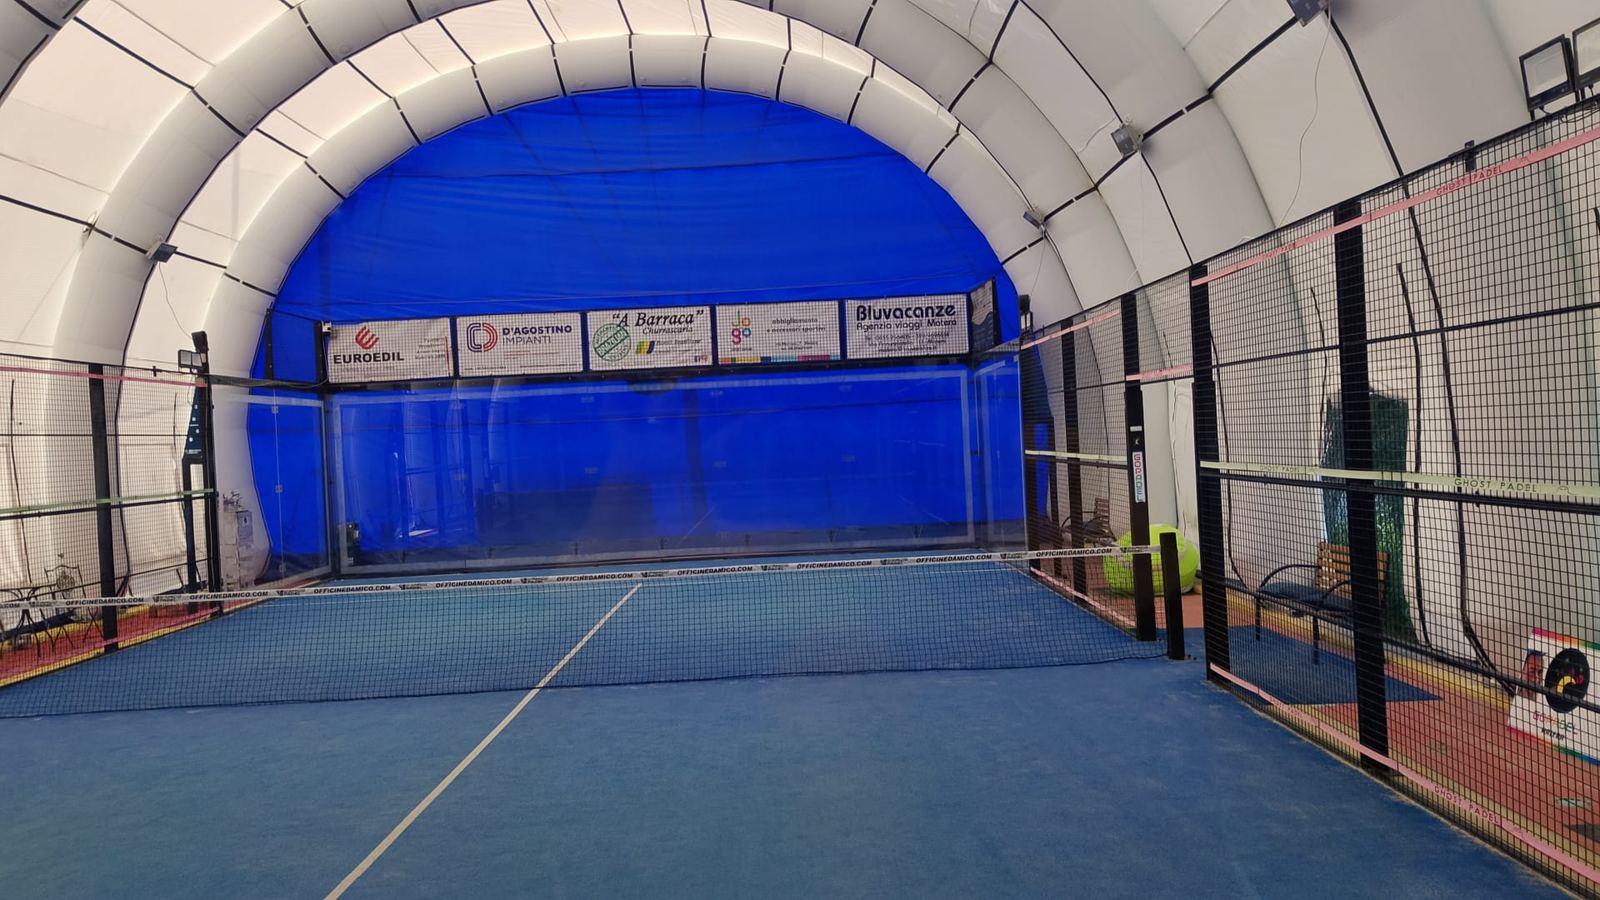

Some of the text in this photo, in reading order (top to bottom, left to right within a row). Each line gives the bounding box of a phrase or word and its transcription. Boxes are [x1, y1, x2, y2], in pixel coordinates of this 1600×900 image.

[1436, 166, 1502, 196] GHOST PADEL
[856, 305, 957, 321] Bluvacanze
[502, 325, 573, 336] D'AGOSTINO
[856, 319, 957, 333] Agenzia viaggi Matera
[502, 335, 551, 345] IMPIANTI
[333, 352, 404, 365] EUROEDIL
[1454, 478, 1537, 493] GHOST PADEL
[1036, 548, 1112, 557] OFFICINEDAMICO.COM
[916, 554, 992, 563] OFFICINEDAMICO.COM
[796, 560, 872, 570] OFFICINEDAMICO.COM
[677, 566, 753, 576] OFFICINEDAMICO.COM
[557, 573, 633, 582] OFFICINEDAMICO.COM
[435, 579, 512, 588] OFFICINEDAMICO.COM
[313, 585, 391, 594] OFFICINEDAMICO.COM
[190, 591, 269, 600] OFFICINEDAMICO.COM
[1434, 785, 1499, 824] GHOST PADEL
